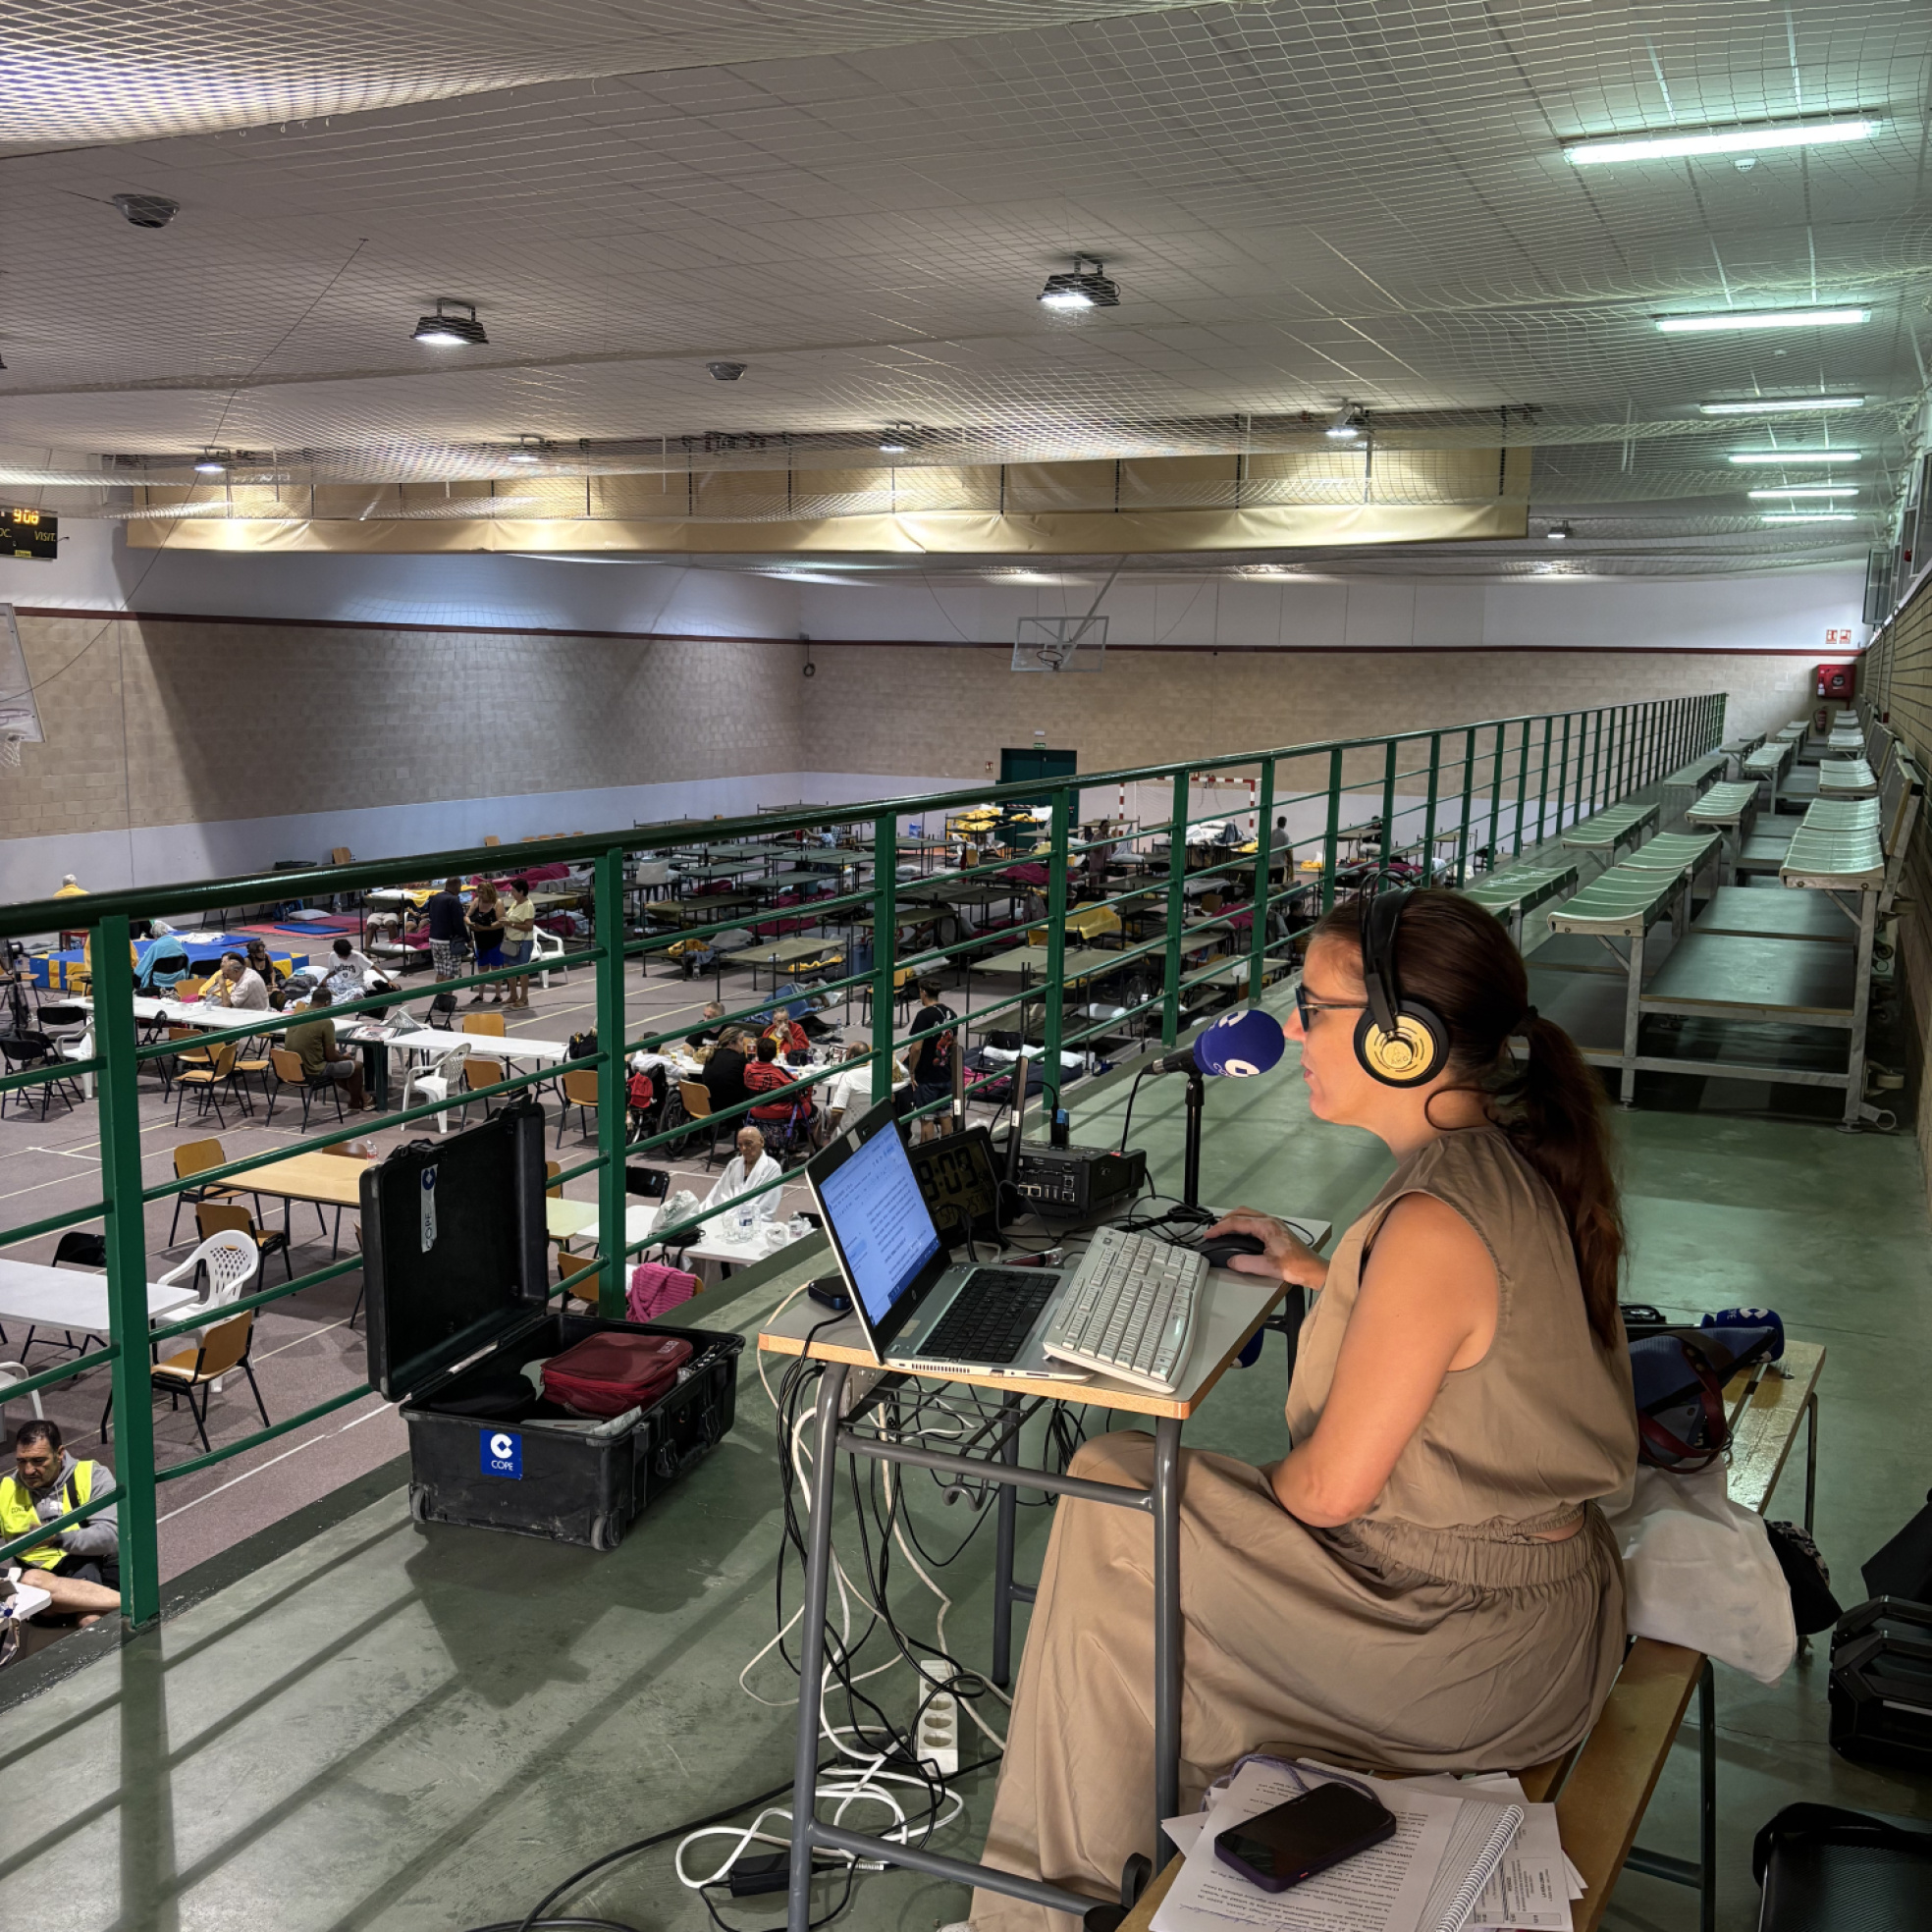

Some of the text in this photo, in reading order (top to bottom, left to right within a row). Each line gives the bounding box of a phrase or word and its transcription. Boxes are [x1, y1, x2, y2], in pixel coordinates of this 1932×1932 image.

[916, 1146, 979, 1203] 9:03
[424, 1212, 433, 1249] COPE
[491, 1460, 513, 1472] COPE
